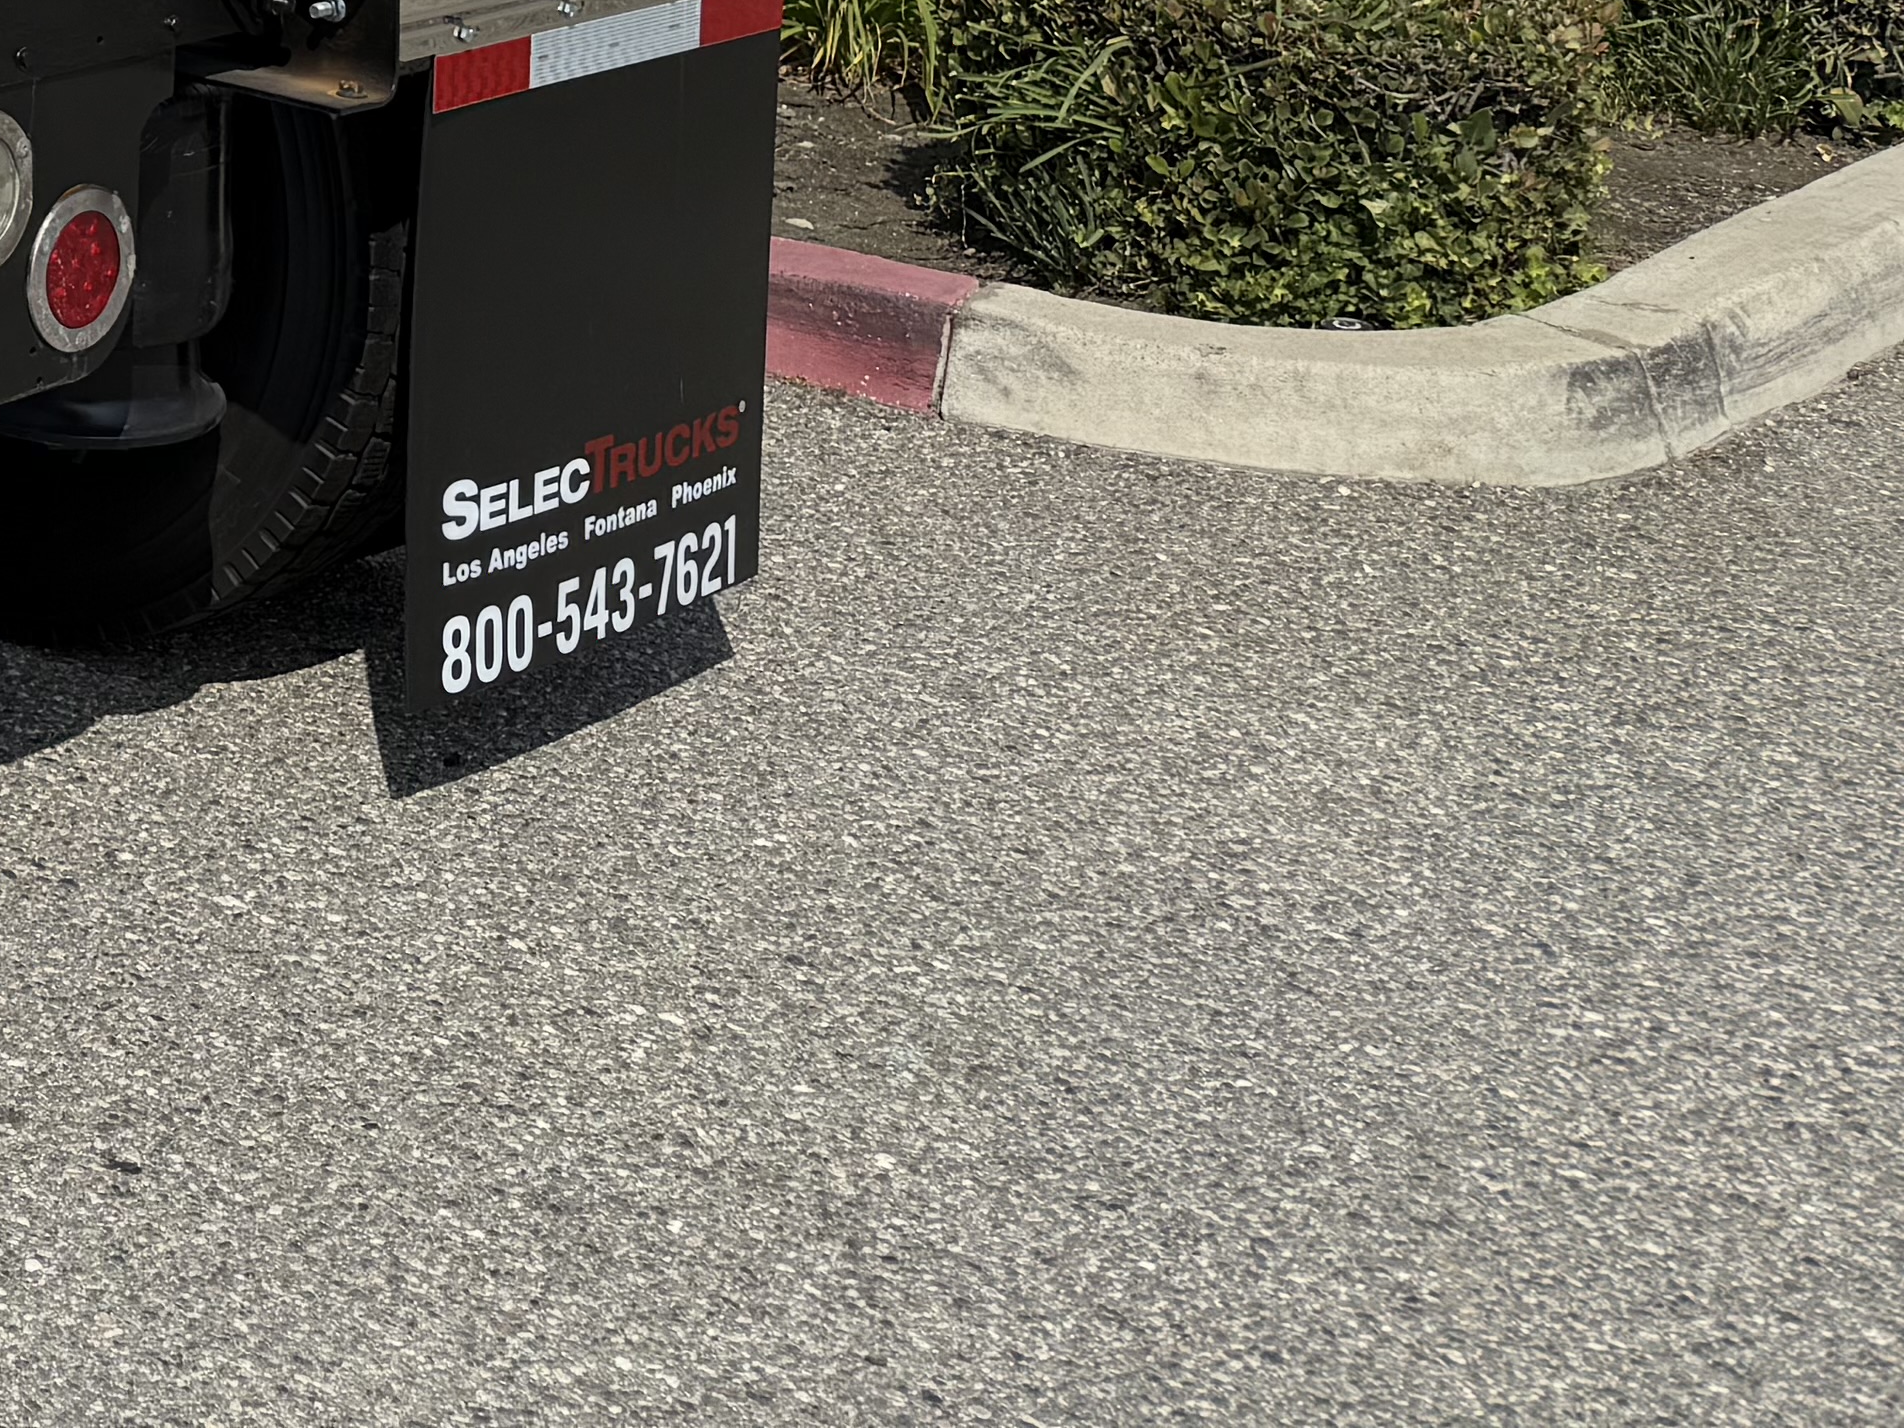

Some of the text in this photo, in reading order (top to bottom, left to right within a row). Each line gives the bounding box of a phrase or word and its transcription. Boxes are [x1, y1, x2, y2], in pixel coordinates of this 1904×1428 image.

[441, 405, 740, 542] SELECTRUCKS
[442, 466, 737, 587] Los Angeles Fontana Phoenix
[441, 514, 737, 695] 800-543-7621
